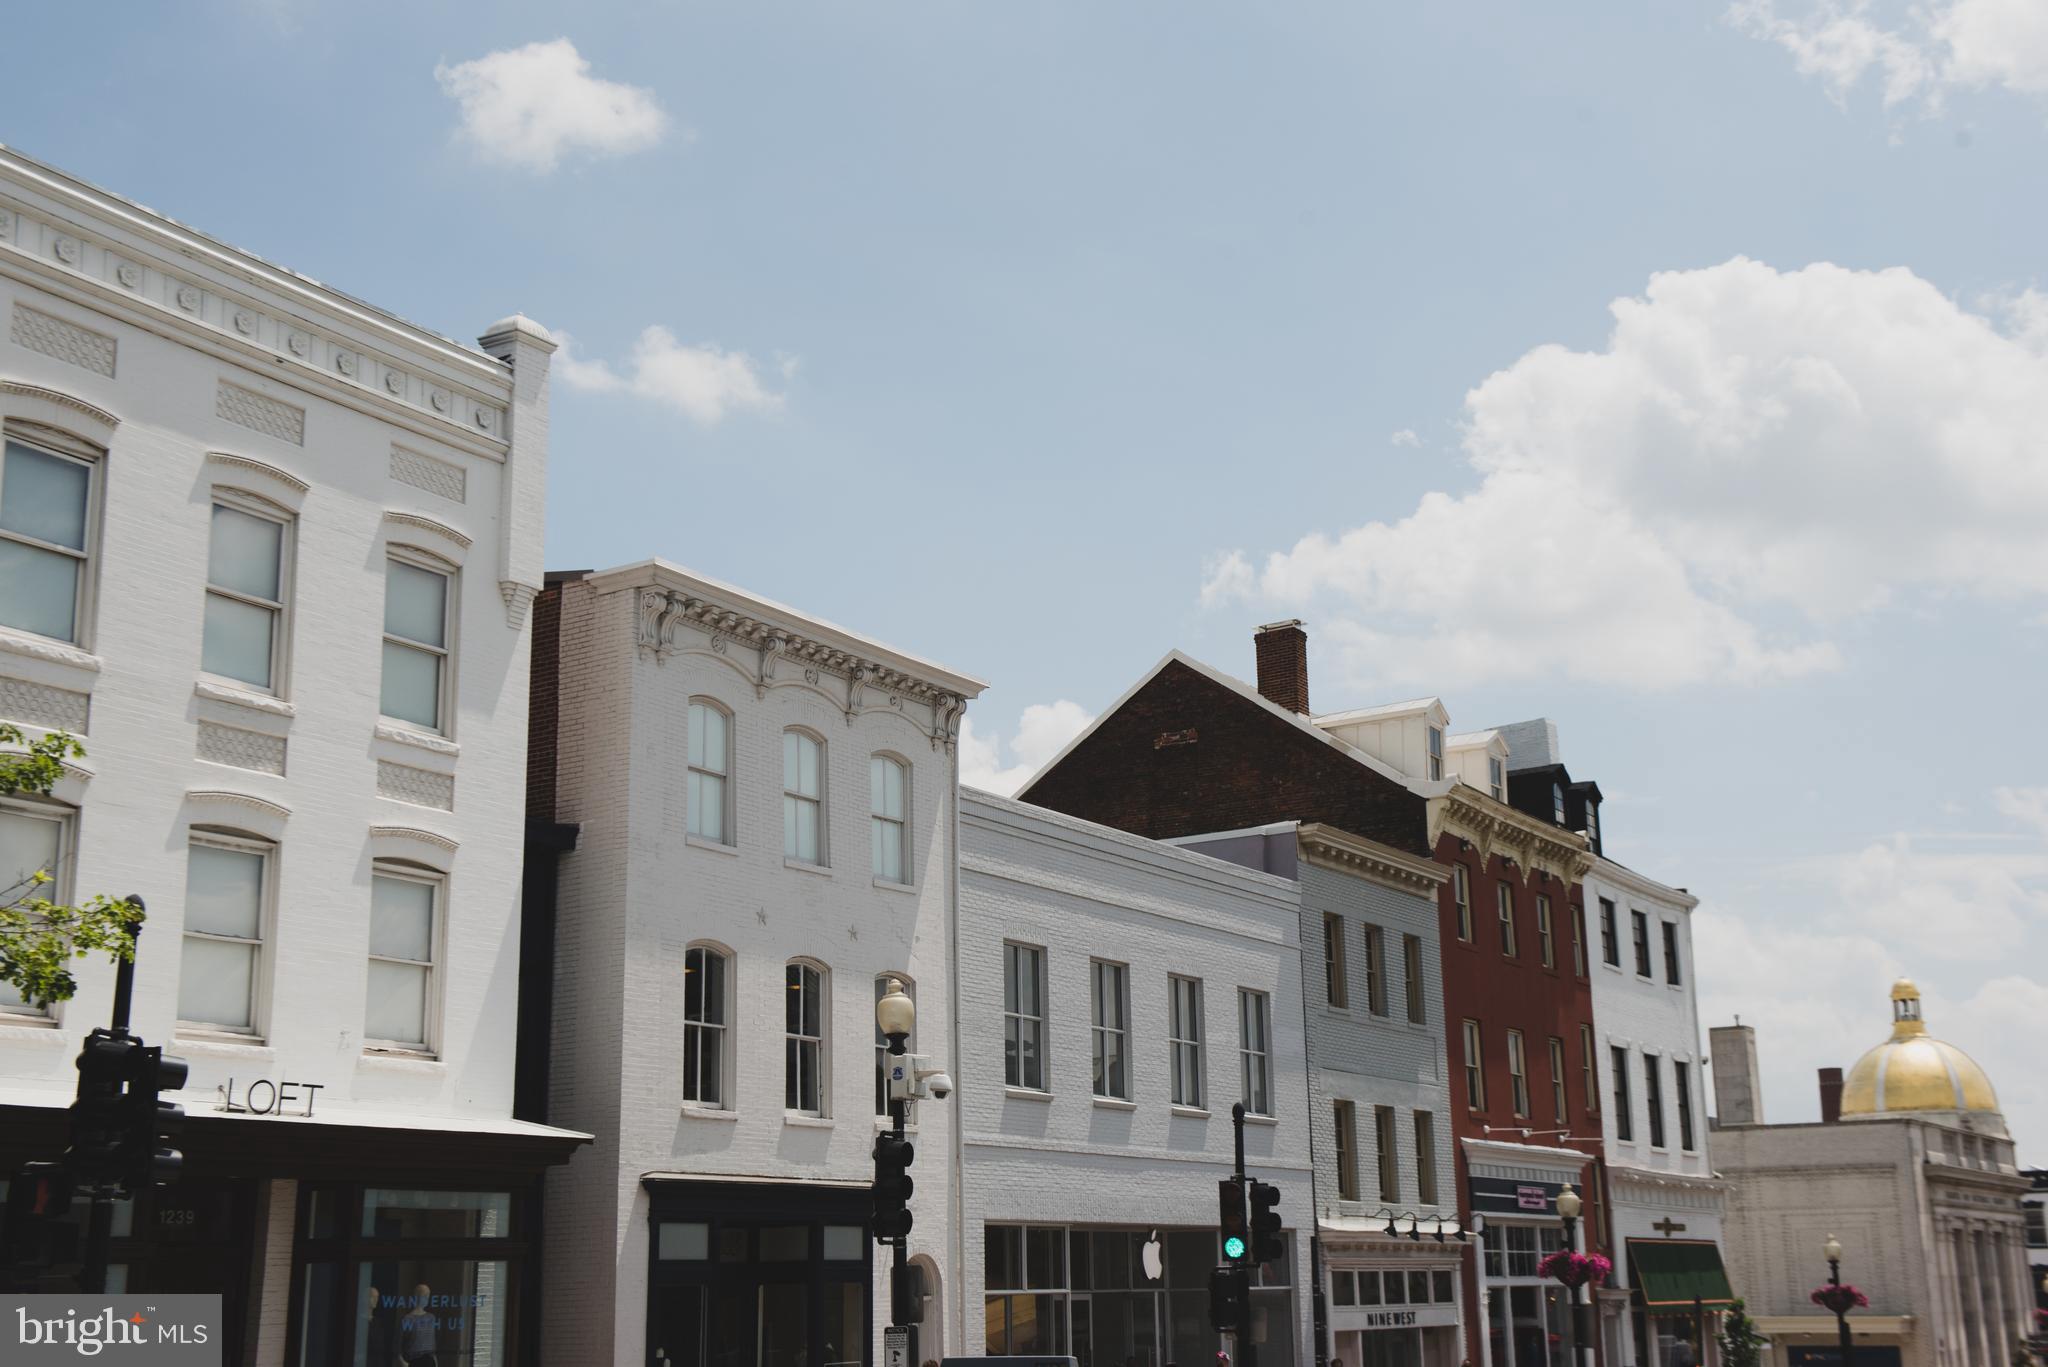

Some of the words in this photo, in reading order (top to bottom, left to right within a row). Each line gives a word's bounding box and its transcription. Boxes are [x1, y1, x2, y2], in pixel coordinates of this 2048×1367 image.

[226, 1077, 324, 1118] LOFT
[159, 1209, 194, 1225] 1239
[401, 1317, 441, 1331] WITH
[448, 1317, 465, 1331] US
[1367, 1311, 1392, 1327] NINE
[1392, 1310, 1417, 1326] WEST
